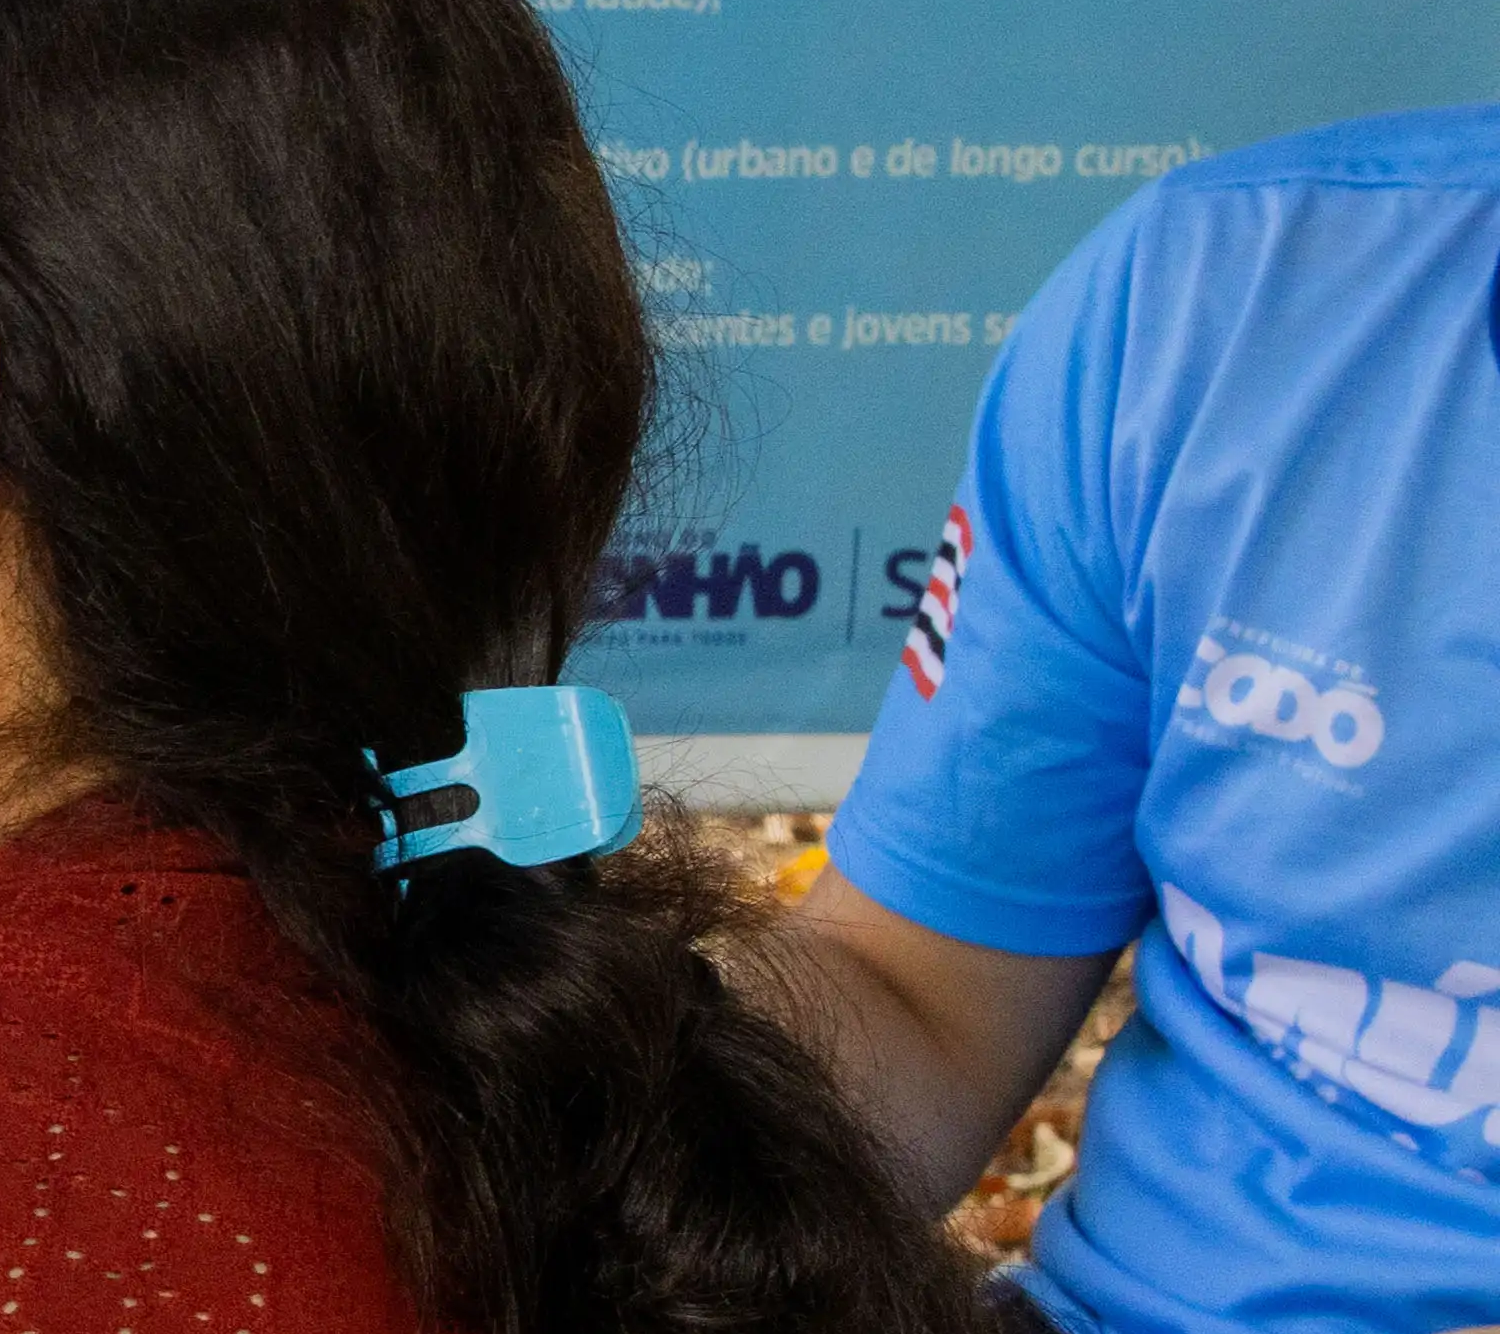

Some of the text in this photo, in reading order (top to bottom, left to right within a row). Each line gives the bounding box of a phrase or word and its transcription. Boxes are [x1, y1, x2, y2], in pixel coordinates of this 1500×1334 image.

[682, 139, 838, 181] (urbano
[849, 144, 876, 179] e
[885, 138, 938, 178] de
[950, 137, 1064, 182] longo
[807, 314, 832, 346] e
[842, 307, 972, 351] jovens
